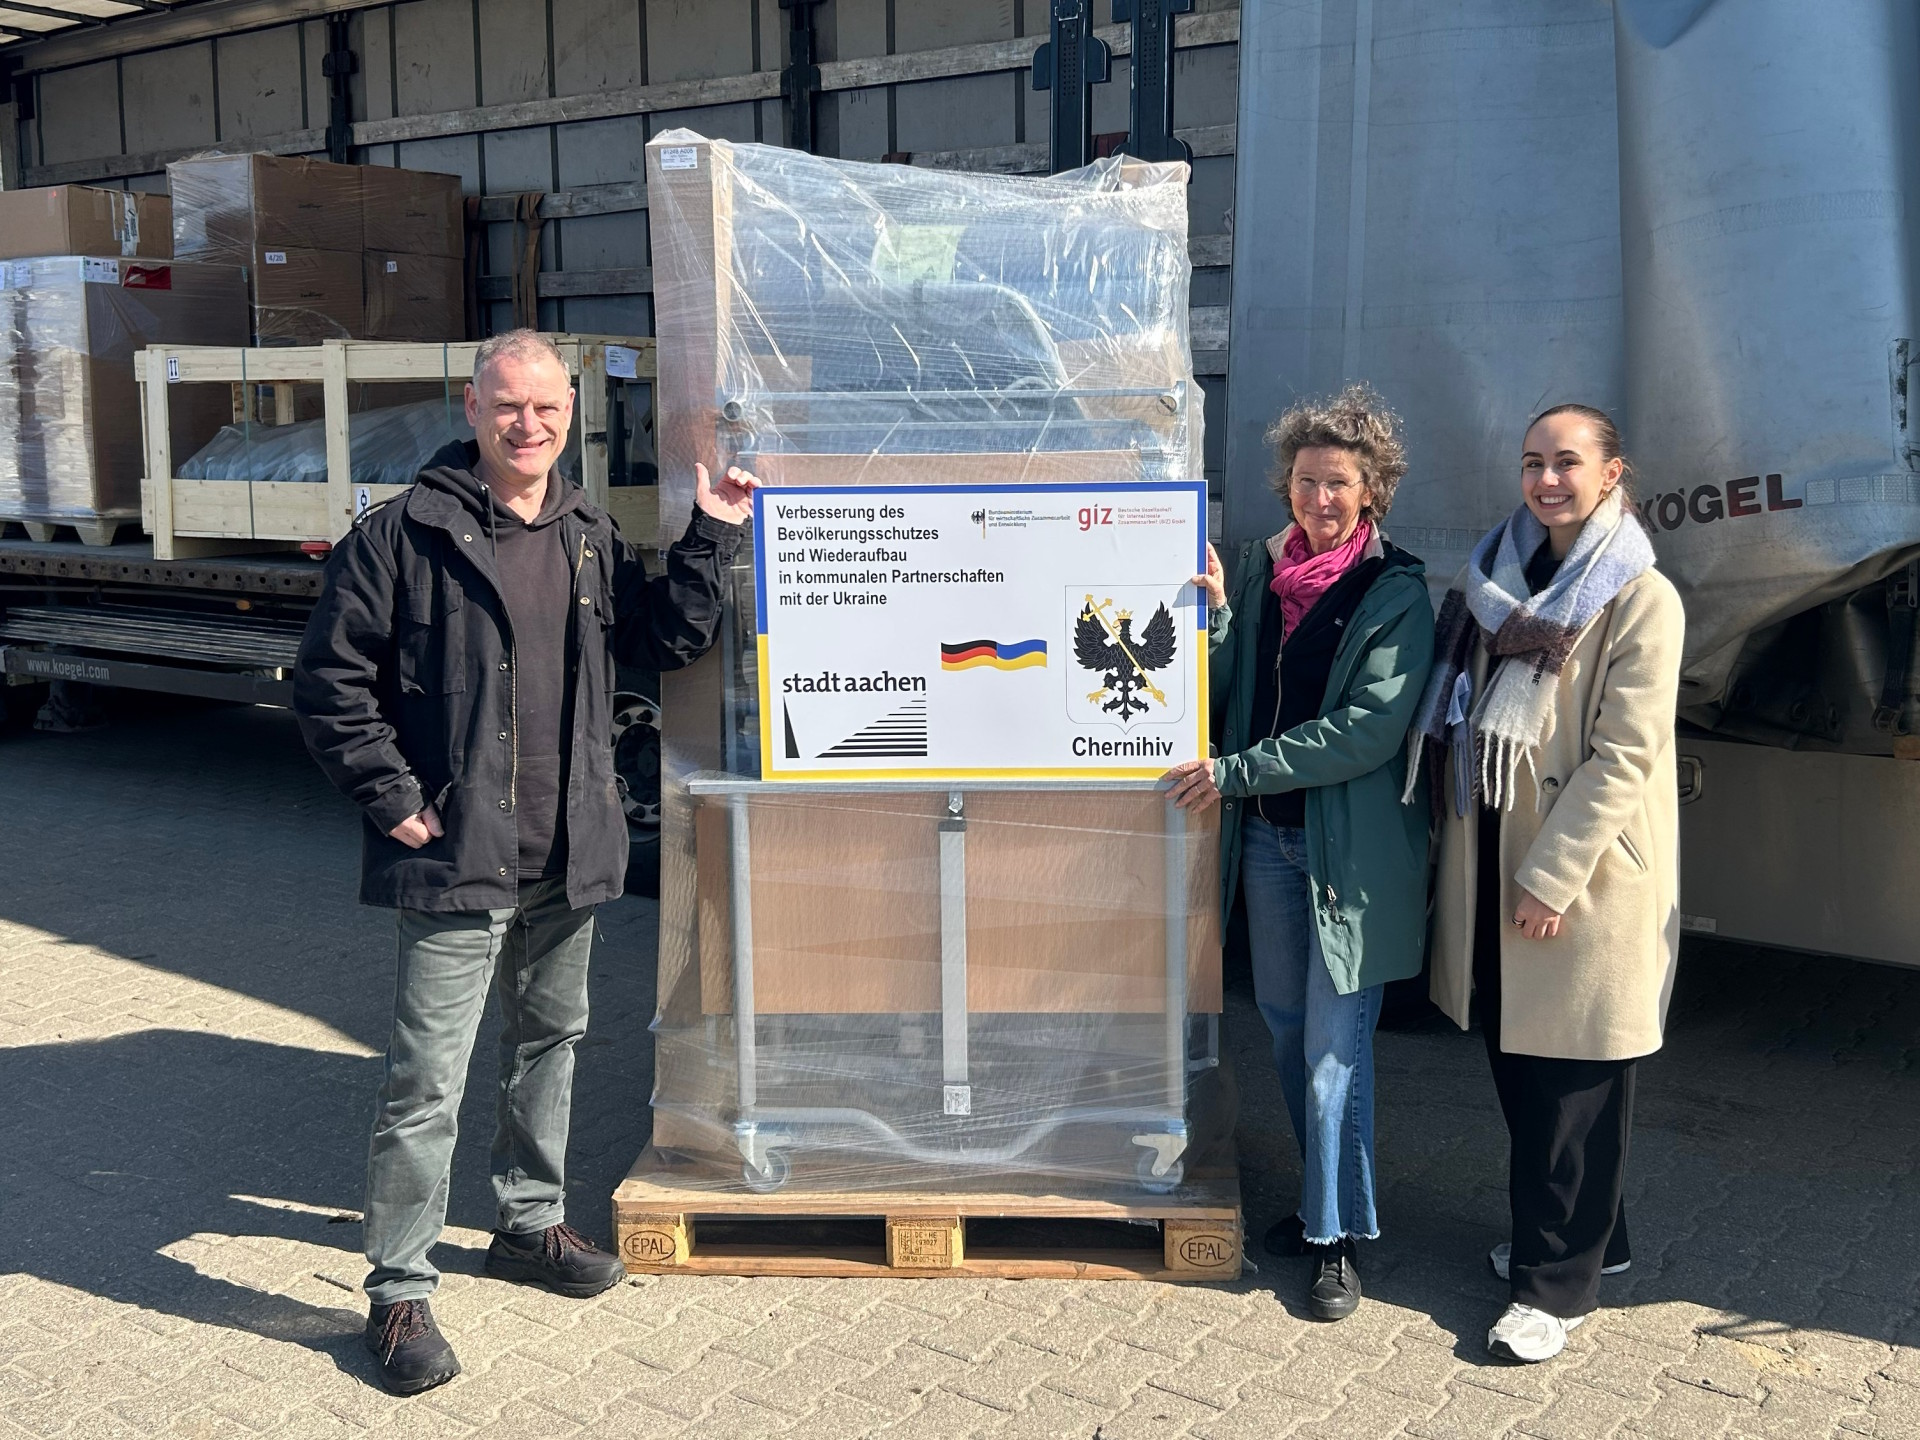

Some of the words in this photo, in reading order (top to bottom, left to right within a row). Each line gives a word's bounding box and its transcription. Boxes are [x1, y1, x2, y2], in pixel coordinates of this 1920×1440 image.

[268, 254, 284, 263] 4/20
[776, 505, 875, 521] Verbesserung
[879, 504, 905, 519] des
[1637, 473, 1804, 535] KÖGEL
[1078, 503, 1113, 532] giz
[777, 526, 939, 543] Bevölkerungsschutzes
[778, 548, 805, 563] und
[809, 548, 907, 562] Wiederaufbau
[778, 570, 792, 584] in
[796, 570, 888, 584] kommunalen
[891, 568, 1004, 583] Partnerschaften
[779, 592, 802, 606] mit
[806, 591, 829, 606] der
[833, 590, 888, 605] Ukraine
[27, 658, 110, 681] www.koegel.com
[782, 671, 841, 693] stadt
[844, 670, 927, 692] aachen
[1071, 736, 1174, 757] Chernihiv
[631, 1237, 669, 1255] EPAL
[1187, 1242, 1227, 1260] EPAL
